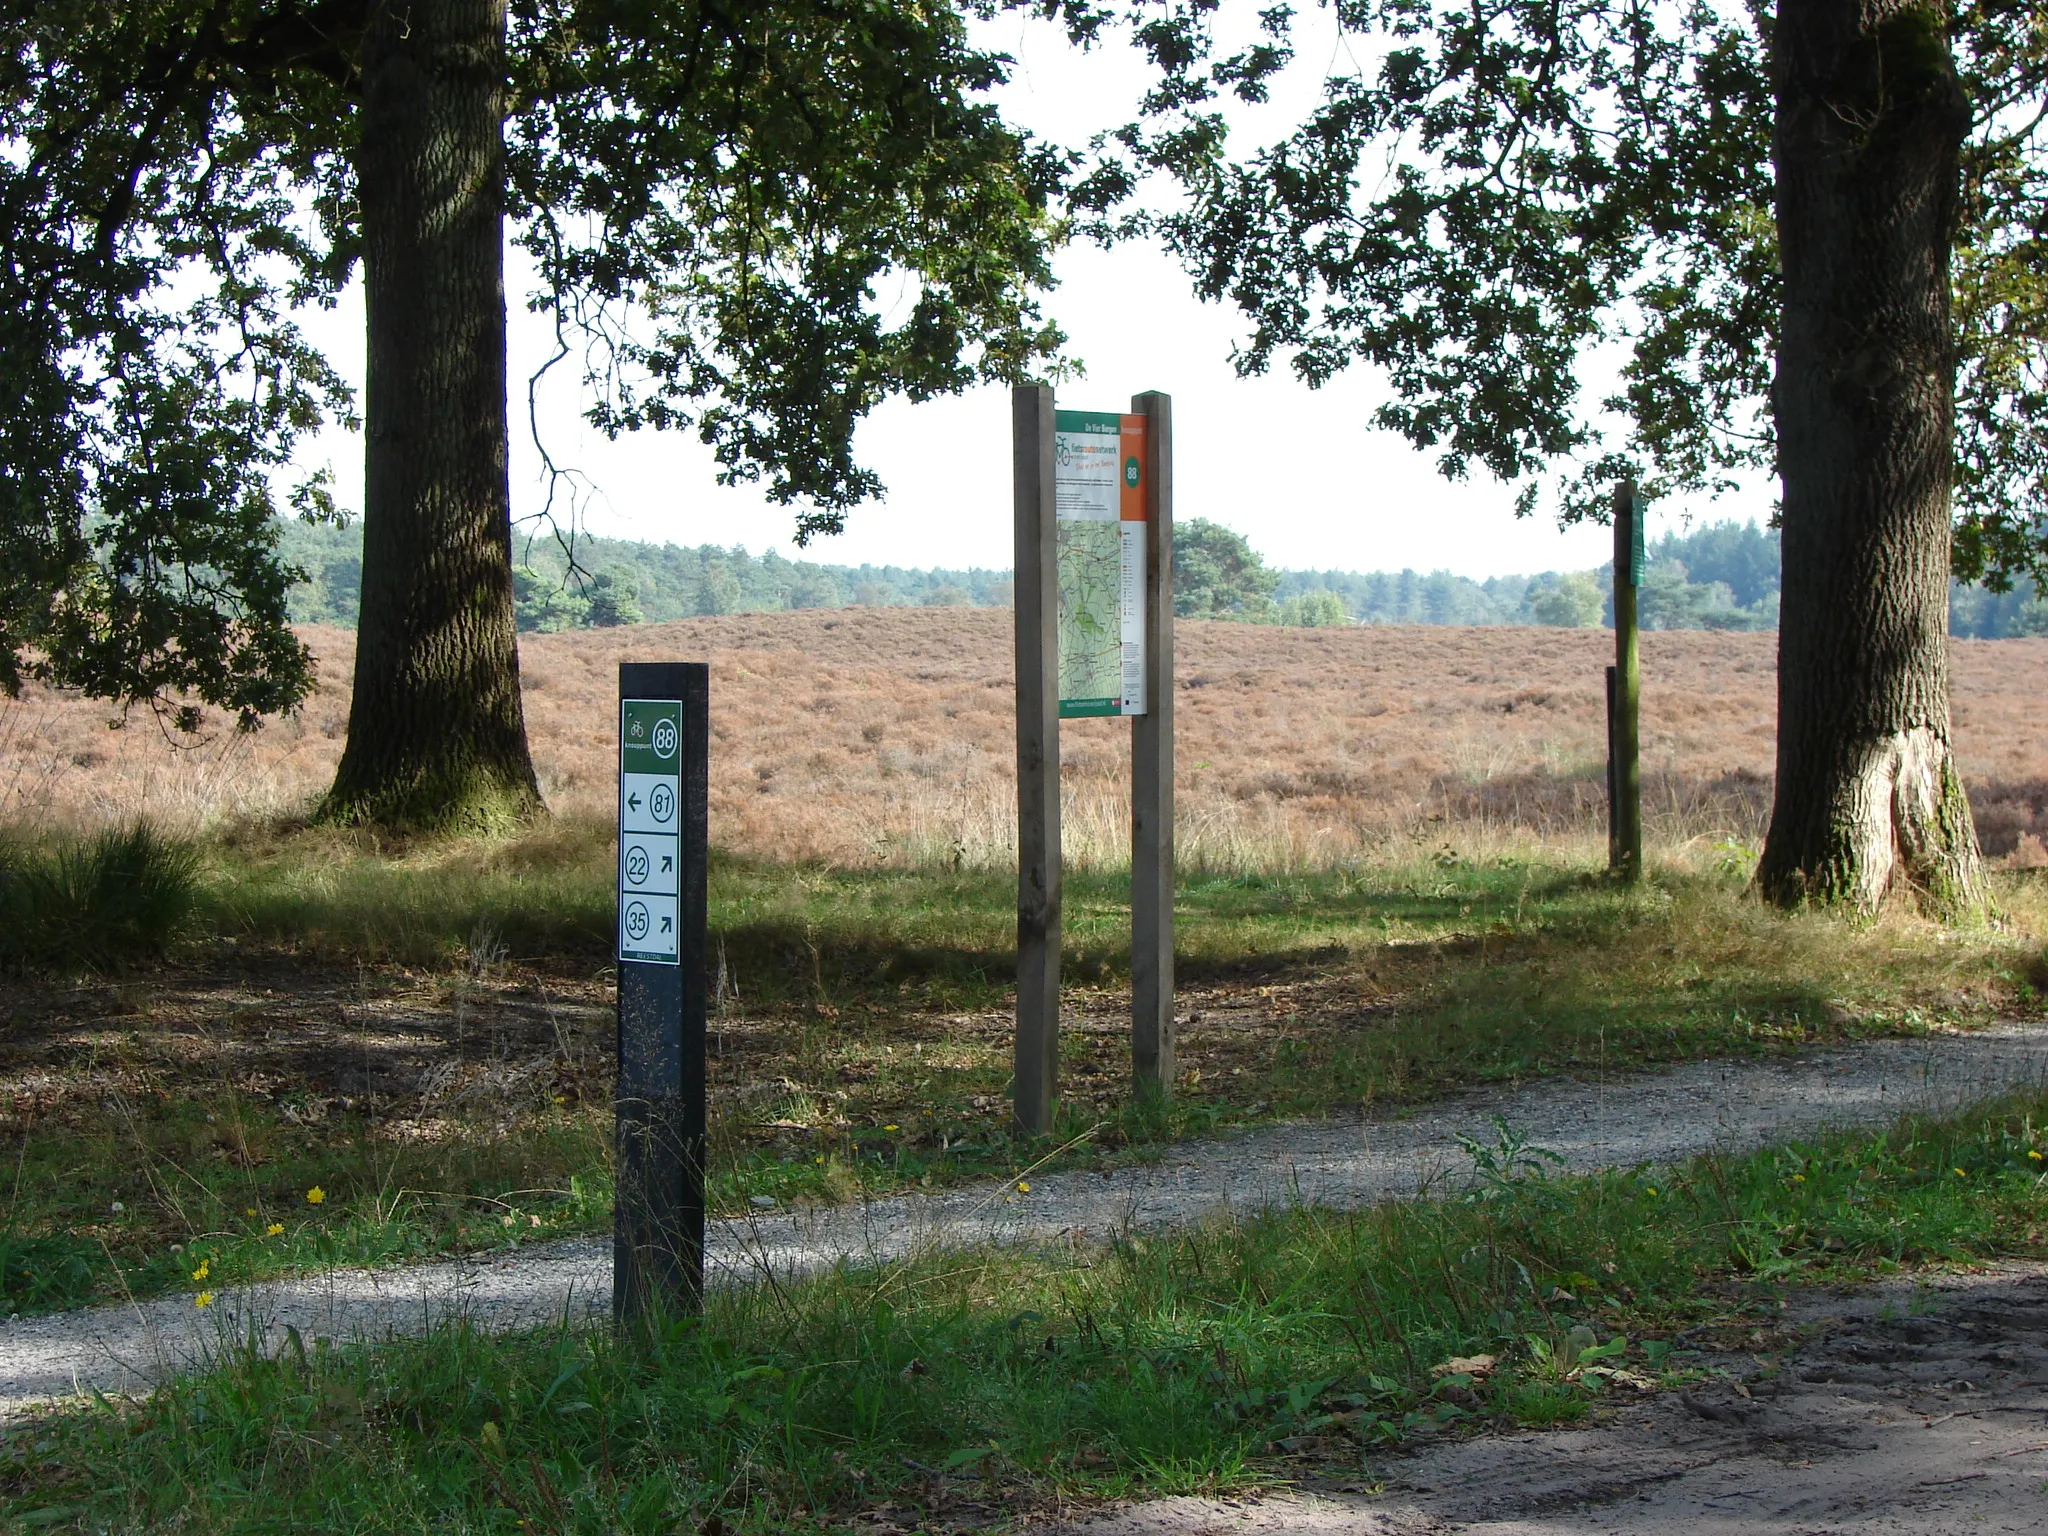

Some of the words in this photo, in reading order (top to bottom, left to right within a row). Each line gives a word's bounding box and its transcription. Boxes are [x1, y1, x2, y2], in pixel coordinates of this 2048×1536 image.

[1127, 467, 1137, 480] 88
[656, 728, 674, 749] 88
[654, 794, 671, 815] 81
[629, 856, 646, 876] 22
[629, 911, 646, 931] 35
